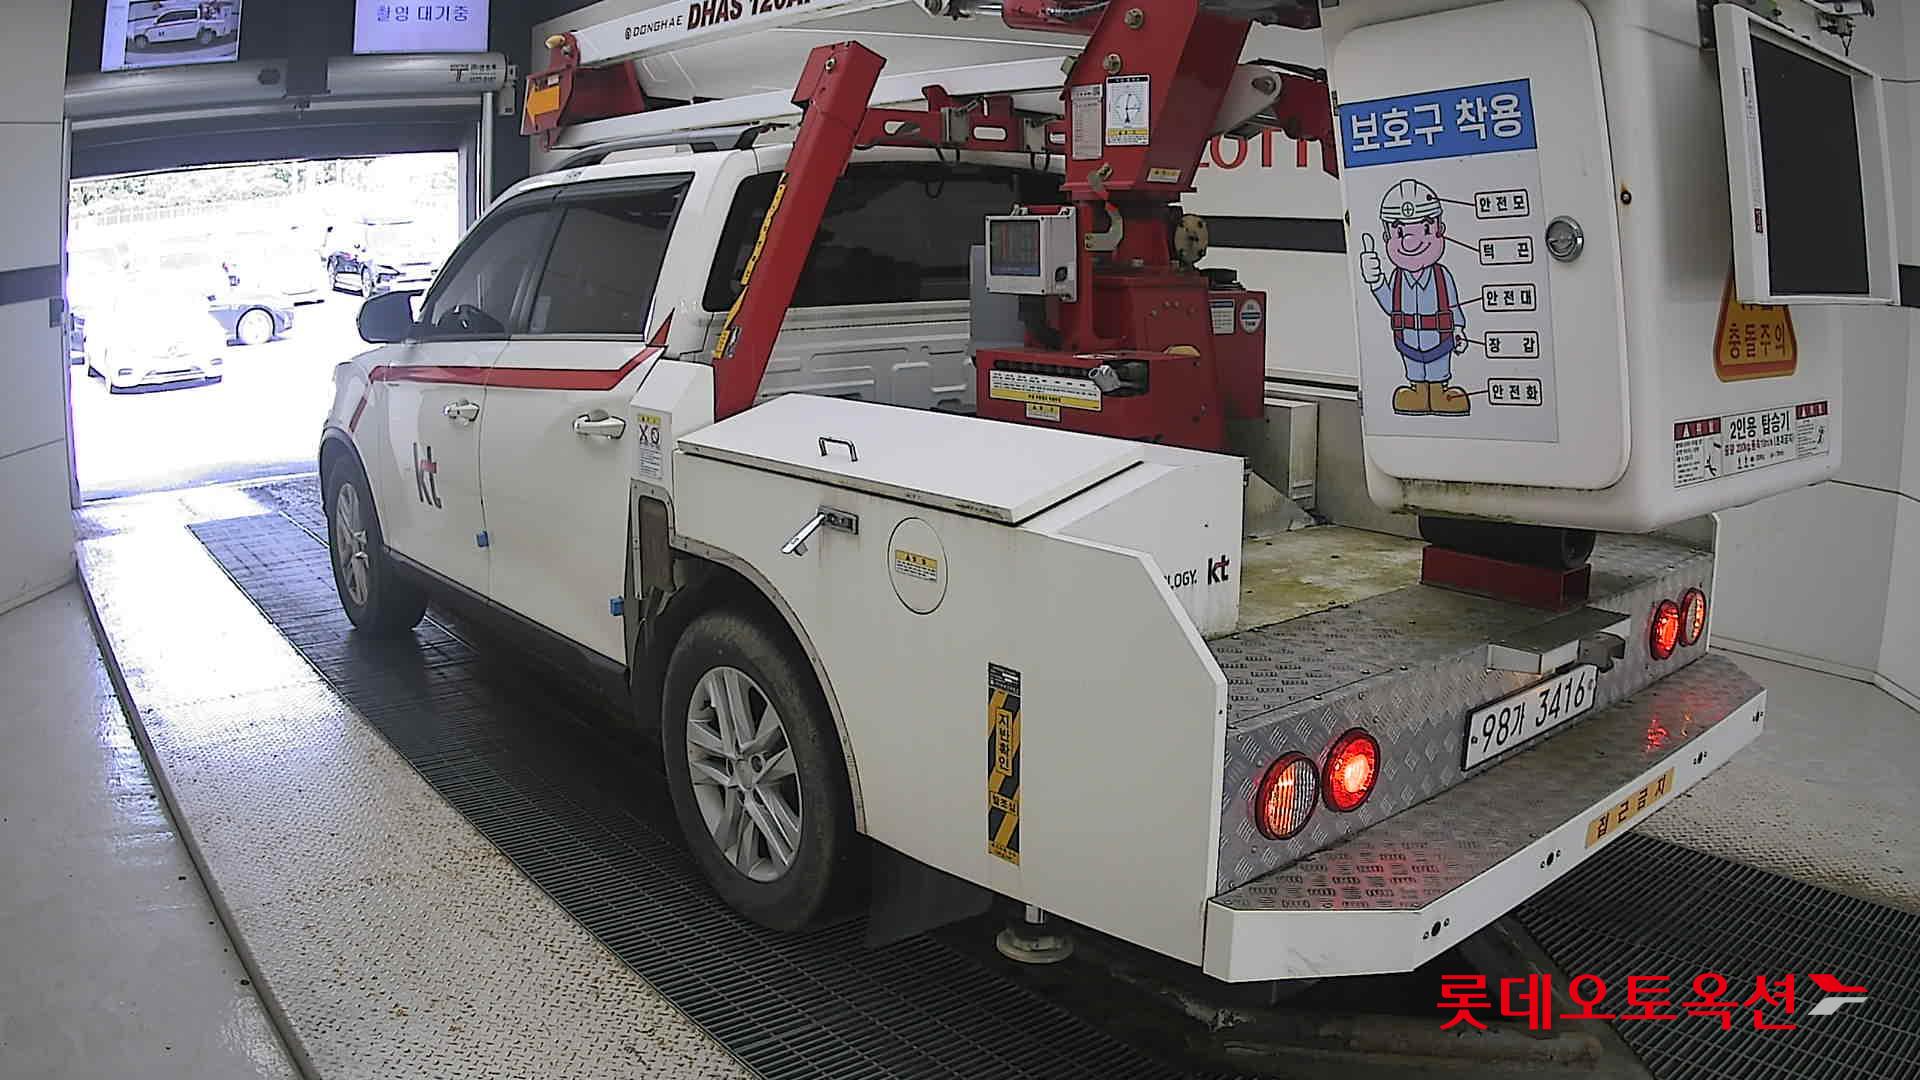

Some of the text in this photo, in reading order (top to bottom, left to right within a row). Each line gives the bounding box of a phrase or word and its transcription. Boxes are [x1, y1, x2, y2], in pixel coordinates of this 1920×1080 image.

[417, 5, 469, 22] 대기중
[633, 15, 683, 37] DONGHAE
[687, 0, 743, 30] DHAS
[1352, 94, 1522, 152] 보호구 착용
[1199, 128, 1308, 169] OTT
[1728, 322, 1786, 359] 충돌주의
[1730, 416, 1757, 440] 2인용
[1762, 410, 1790, 435] 탑승기
[413, 442, 442, 509] kt
[1164, 554, 1229, 590] LOGY. kt
[1482, 671, 1585, 753] 98가 3416
